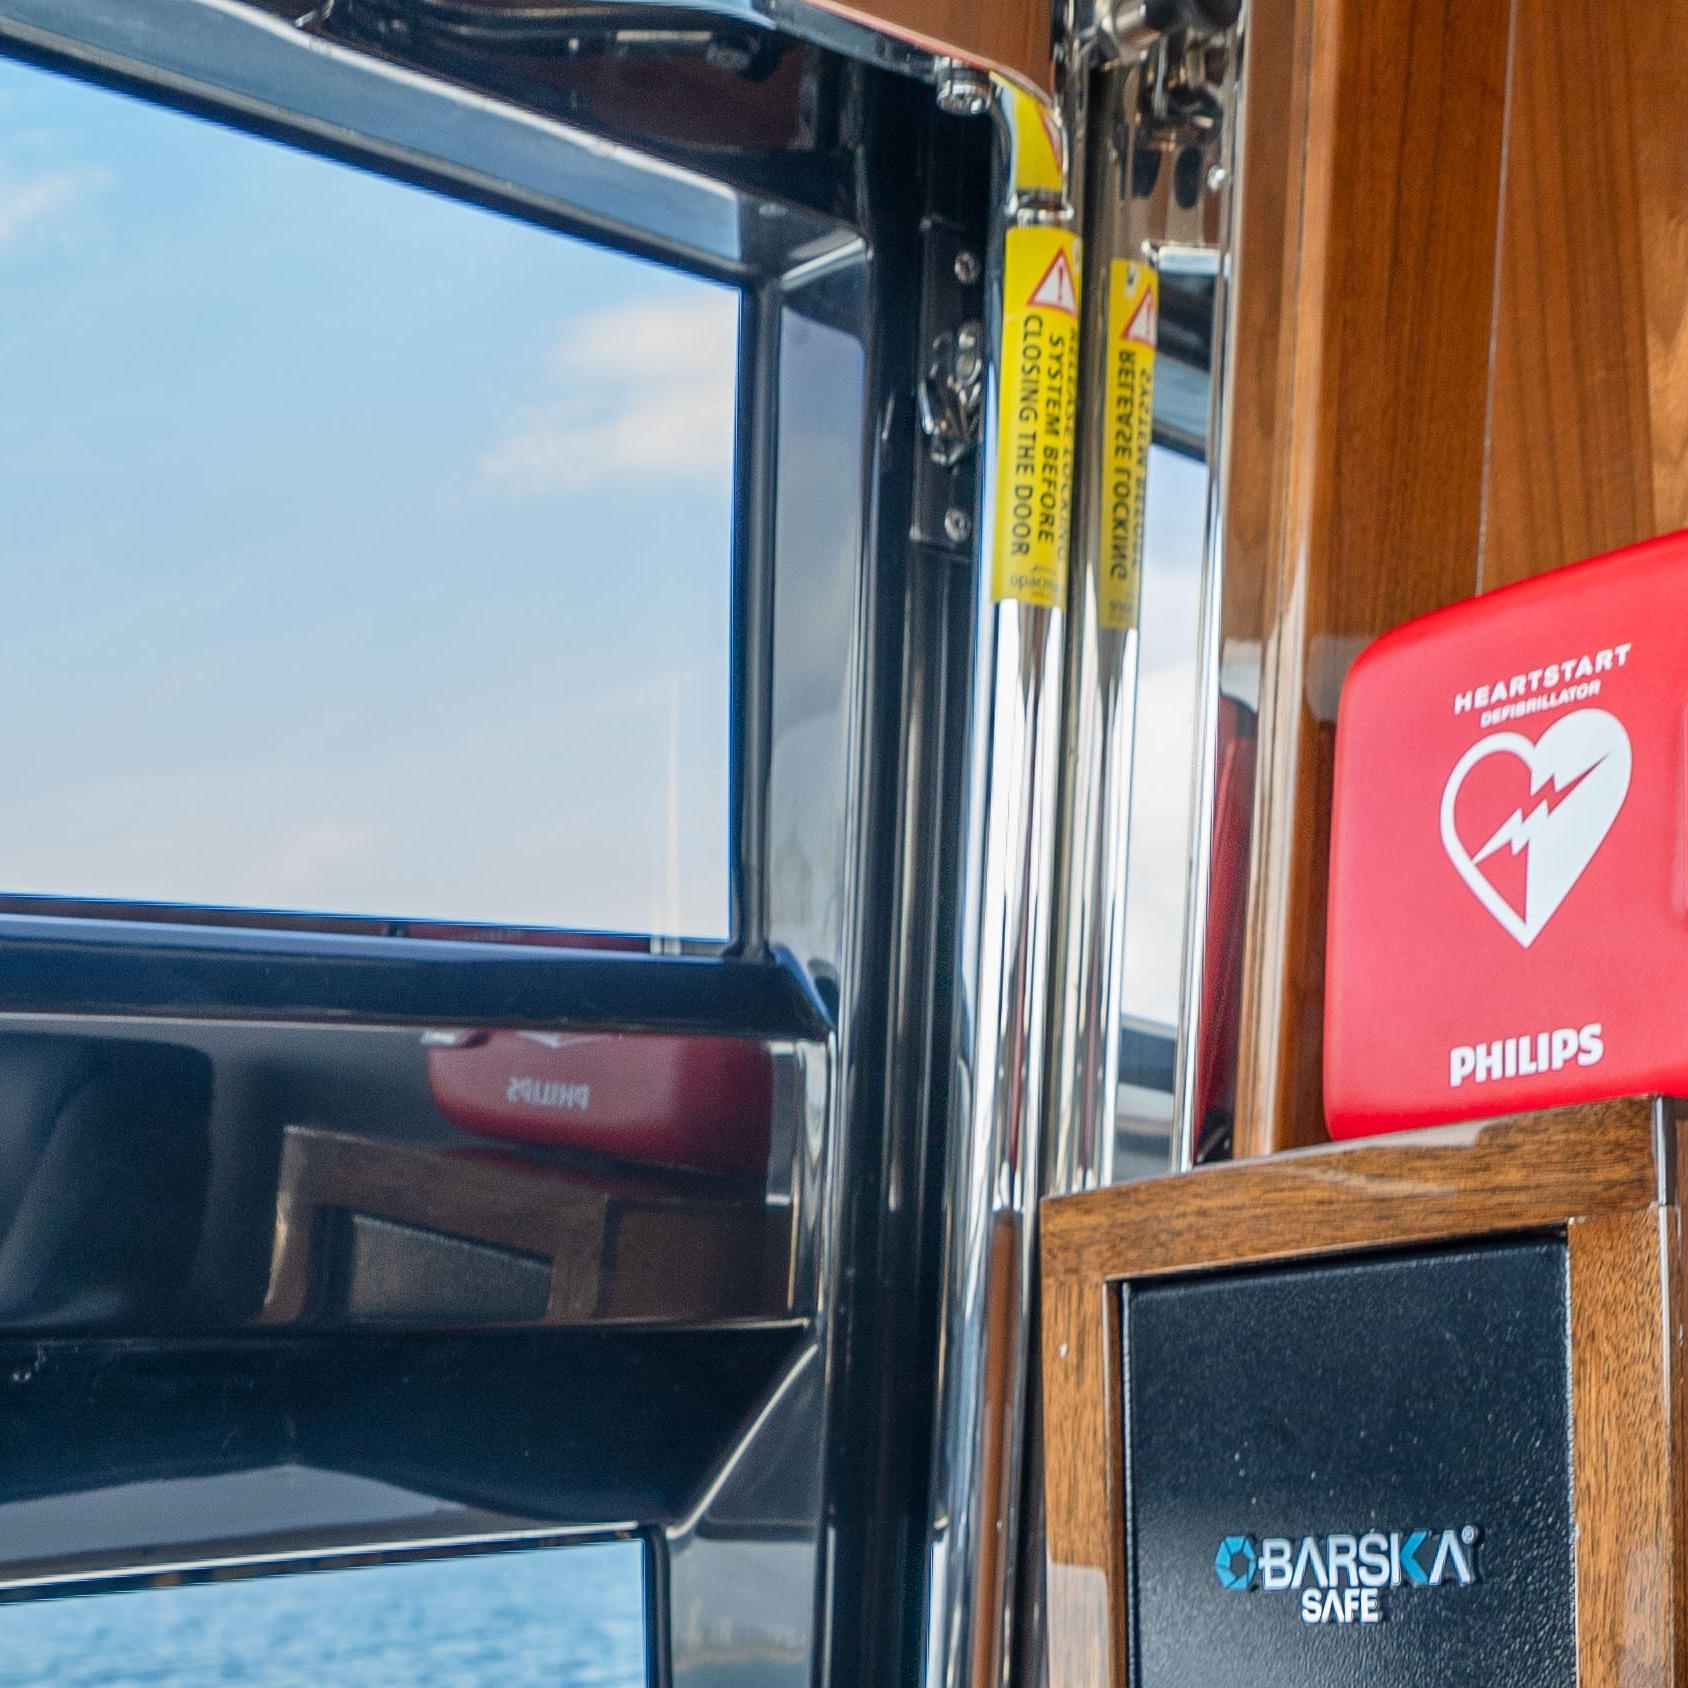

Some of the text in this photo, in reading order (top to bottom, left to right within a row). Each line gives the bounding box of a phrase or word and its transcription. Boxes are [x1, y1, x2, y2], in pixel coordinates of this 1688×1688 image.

[1011, 314, 1043, 556] CLOSING THE DOOR
[1038, 334, 1064, 542] SYSTEM BEFORE
[1454, 642, 1632, 716] HEARTSTART
[1480, 679, 1602, 728] DEFIBRILLATOR
[1449, 1023, 1604, 1088] PHILIPS
[1301, 1588, 1379, 1623] SAFE
